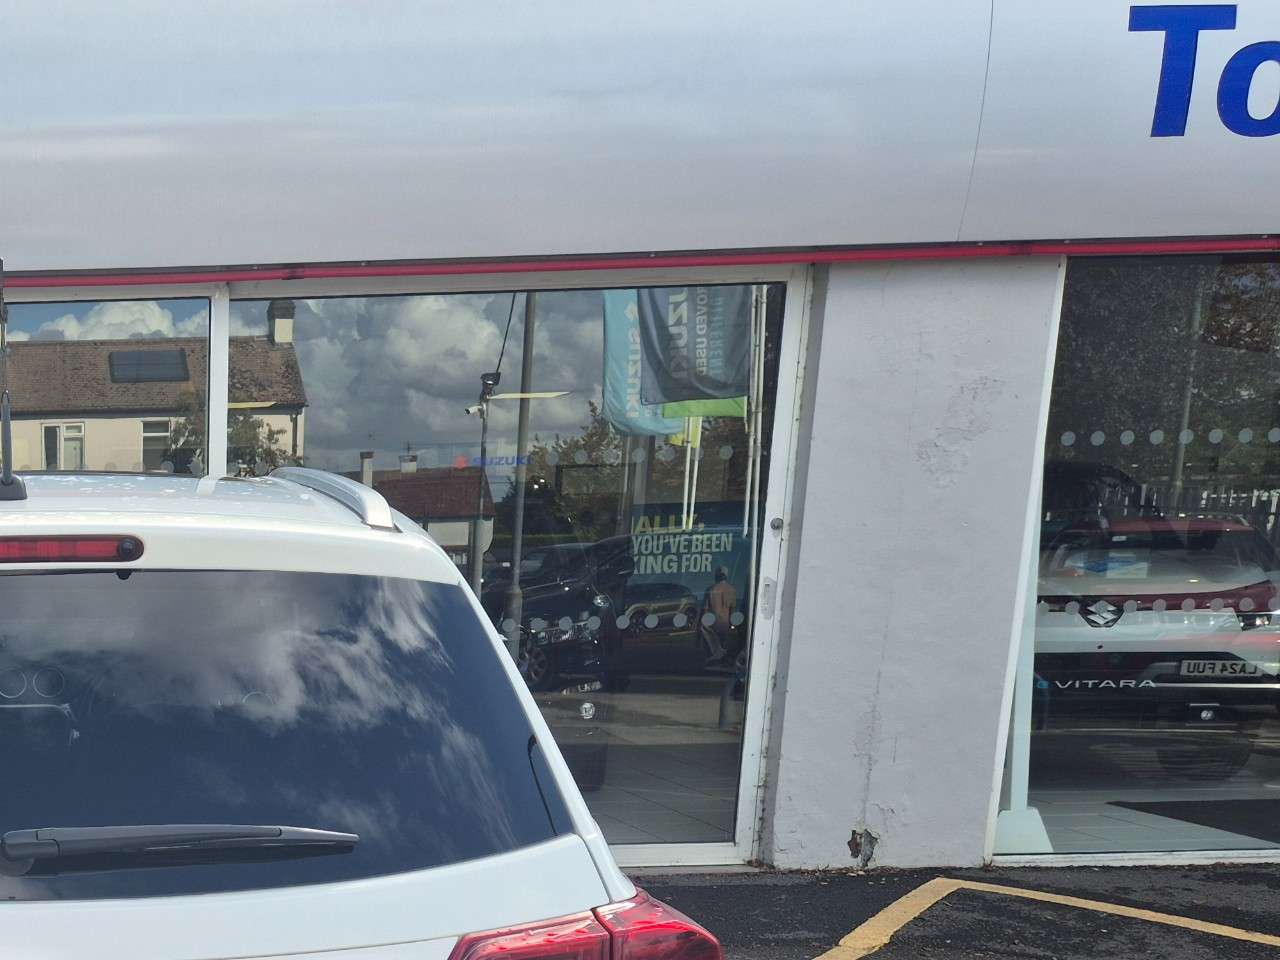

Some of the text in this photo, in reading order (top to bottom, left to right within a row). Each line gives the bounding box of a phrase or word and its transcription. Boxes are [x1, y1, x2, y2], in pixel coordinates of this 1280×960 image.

[1127, 4, 1280, 138] To
[691, 532, 733, 553] BEEN
[681, 553, 713, 574] FOR
[1055, 679, 1157, 689] VITARA
